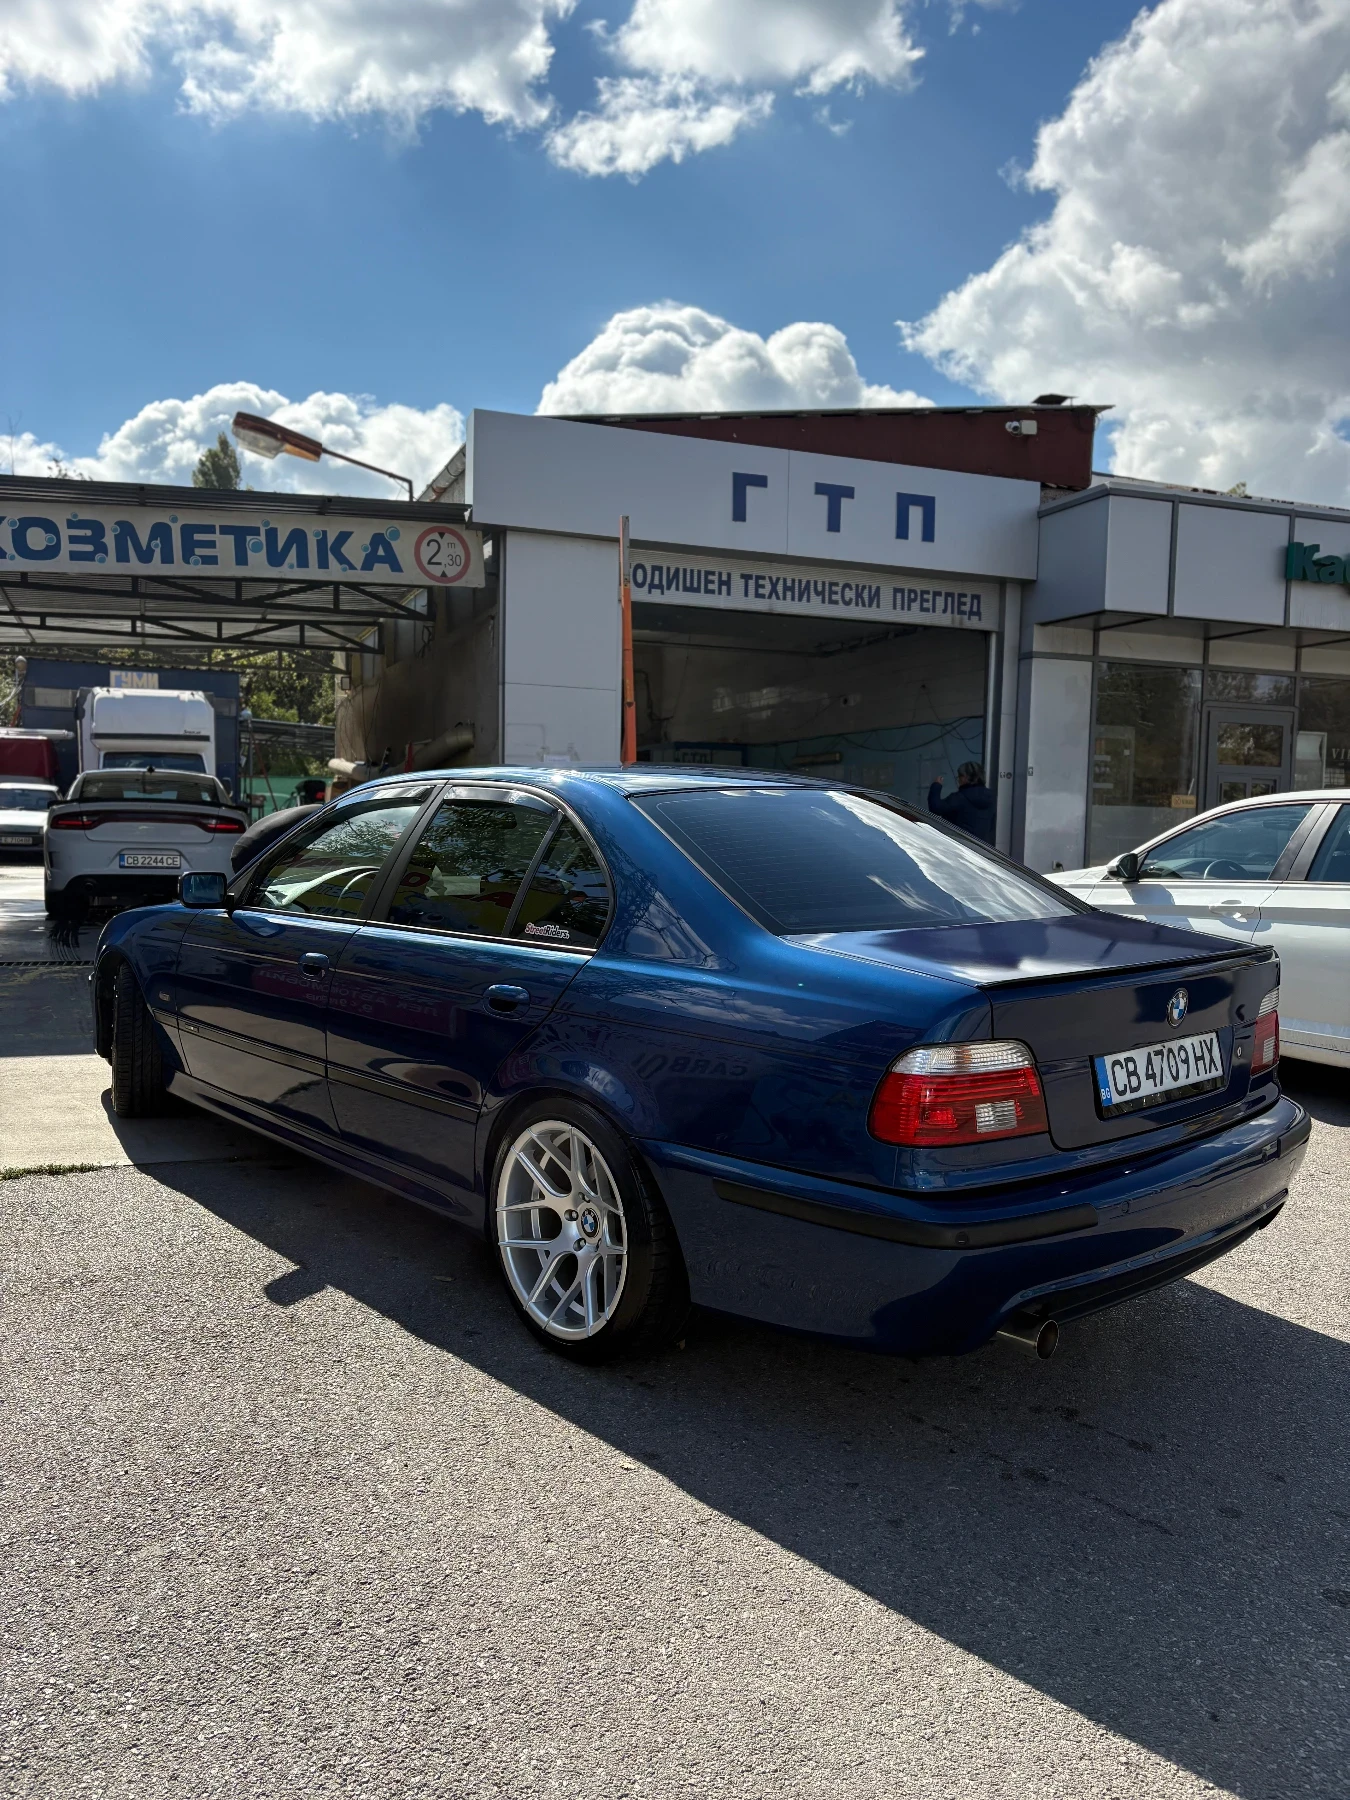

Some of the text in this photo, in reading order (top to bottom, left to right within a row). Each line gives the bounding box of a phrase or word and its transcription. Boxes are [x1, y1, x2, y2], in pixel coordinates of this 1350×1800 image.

[1287, 541, 1350, 584] Ка
[630, 562, 982, 622] ОДИШЕН ТЕХНИЧЕСКИ ПРЕГЛЕД
[110, 670, 159, 689] ГУМИ
[126, 856, 139, 866] CB
[141, 856, 164, 866] 2244
[165, 856, 179, 866] CE
[1111, 1037, 1219, 1097] CB 4709 HX
[1101, 1088, 1111, 1101] BG
